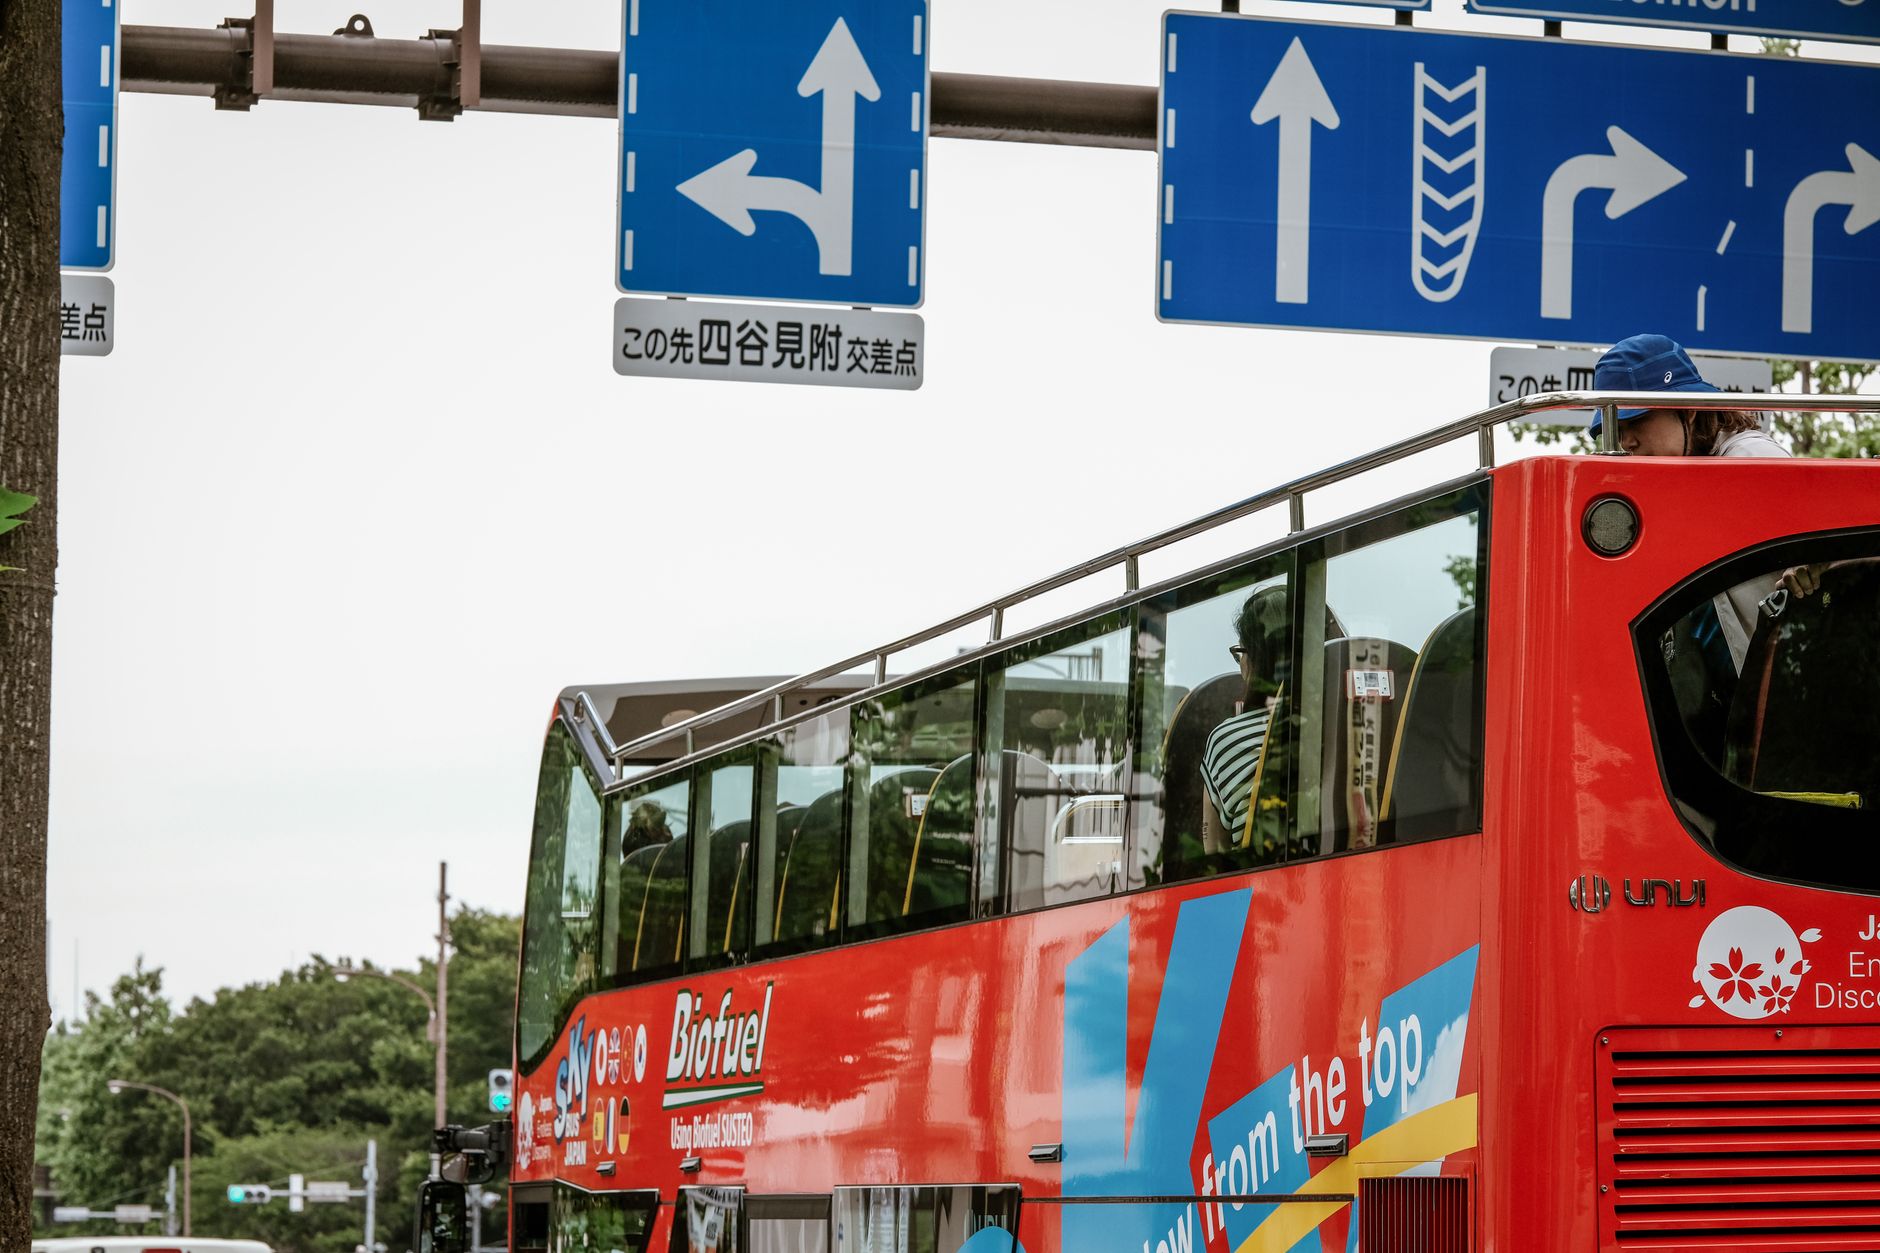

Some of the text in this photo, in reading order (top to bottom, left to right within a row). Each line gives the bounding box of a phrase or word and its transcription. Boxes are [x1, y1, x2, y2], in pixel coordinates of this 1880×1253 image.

[622, 319, 917, 377] この先四谷見附交差点
[1815, 982, 1880, 1009] Disc
[666, 981, 774, 1083] Biofuel
[564, 1140, 587, 1166] JAPAN
[671, 1111, 753, 1158] Using Biofuel SUSTEO
[1202, 1111, 1280, 1244] from
[1289, 1055, 1346, 1154] the
[1358, 1014, 1422, 1114] top
